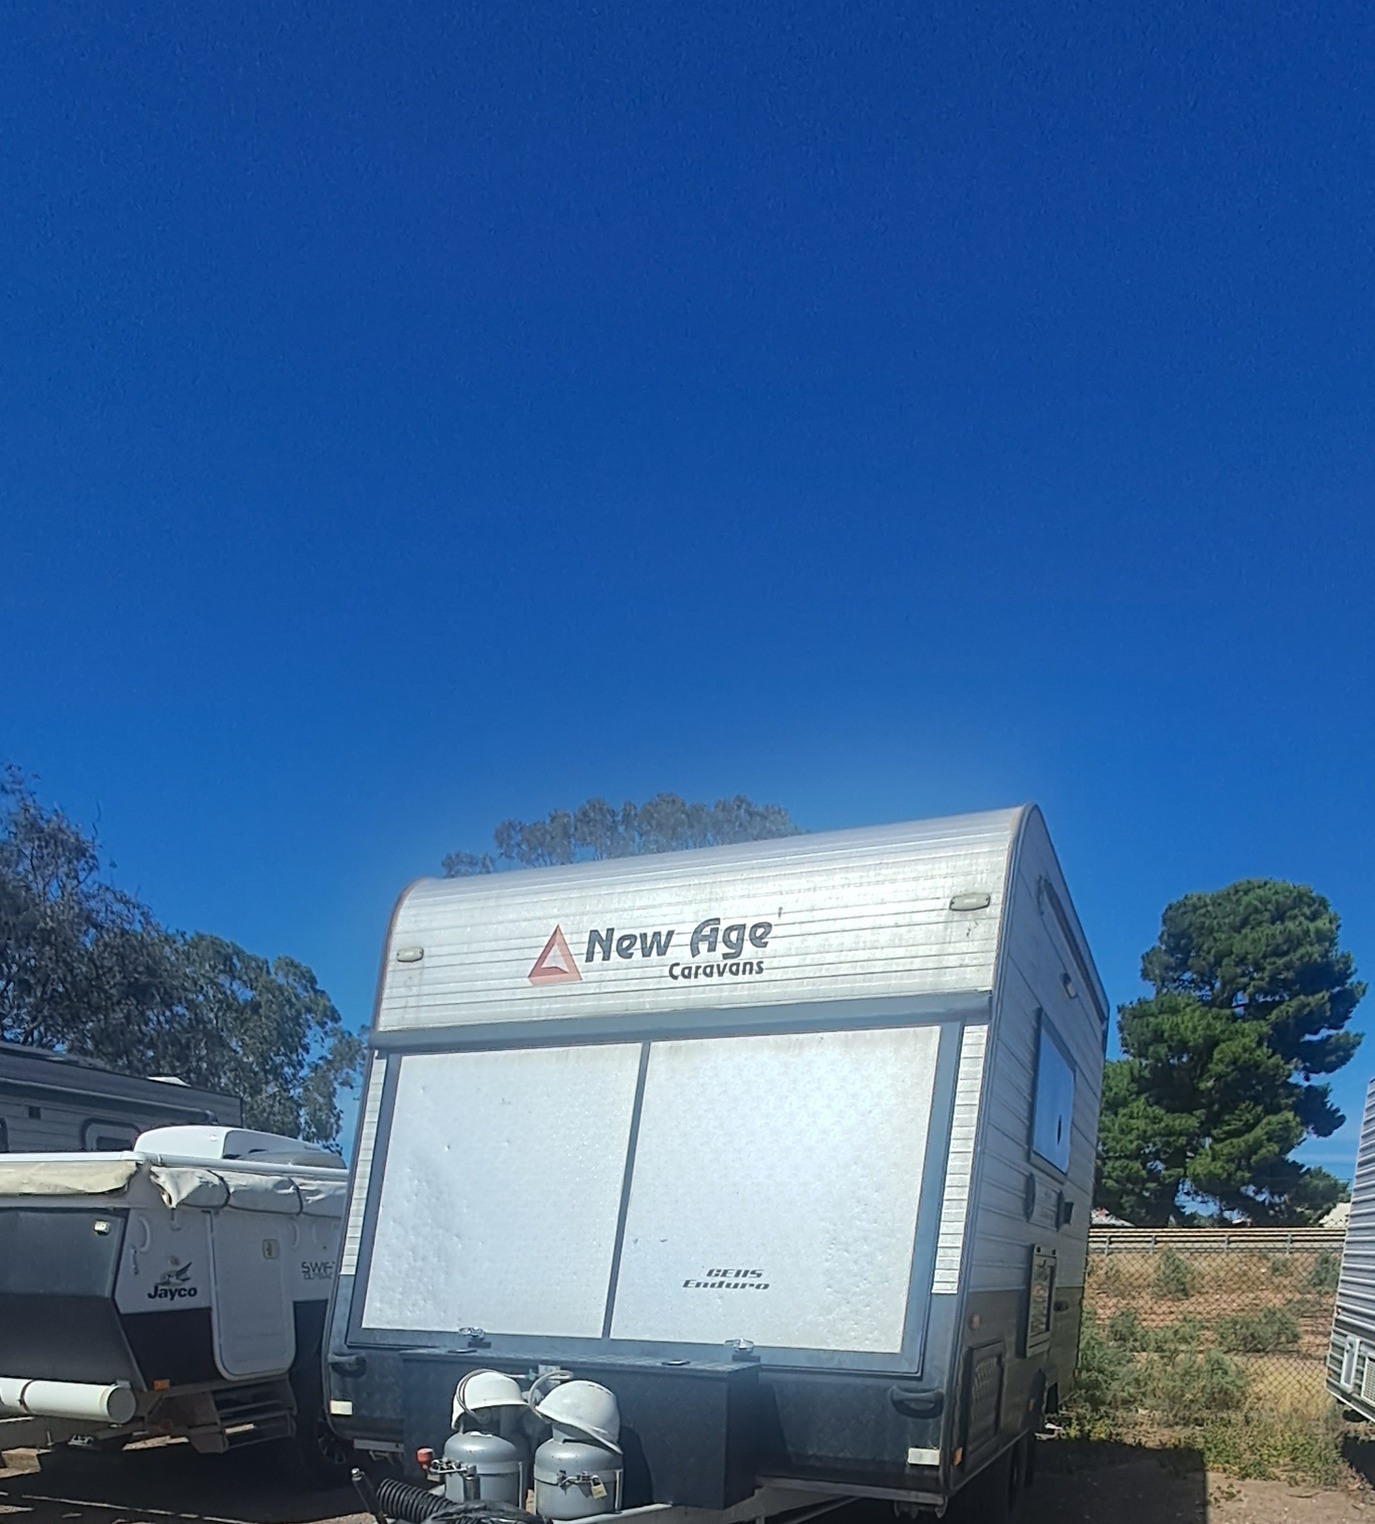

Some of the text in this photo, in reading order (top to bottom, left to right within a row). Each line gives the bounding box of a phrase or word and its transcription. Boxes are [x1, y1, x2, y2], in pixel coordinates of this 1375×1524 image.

[585, 918, 773, 963] New Age
[669, 960, 764, 981] Caravans
[147, 1285, 198, 1301] Jayco
[682, 1279, 770, 1289] Enduro
